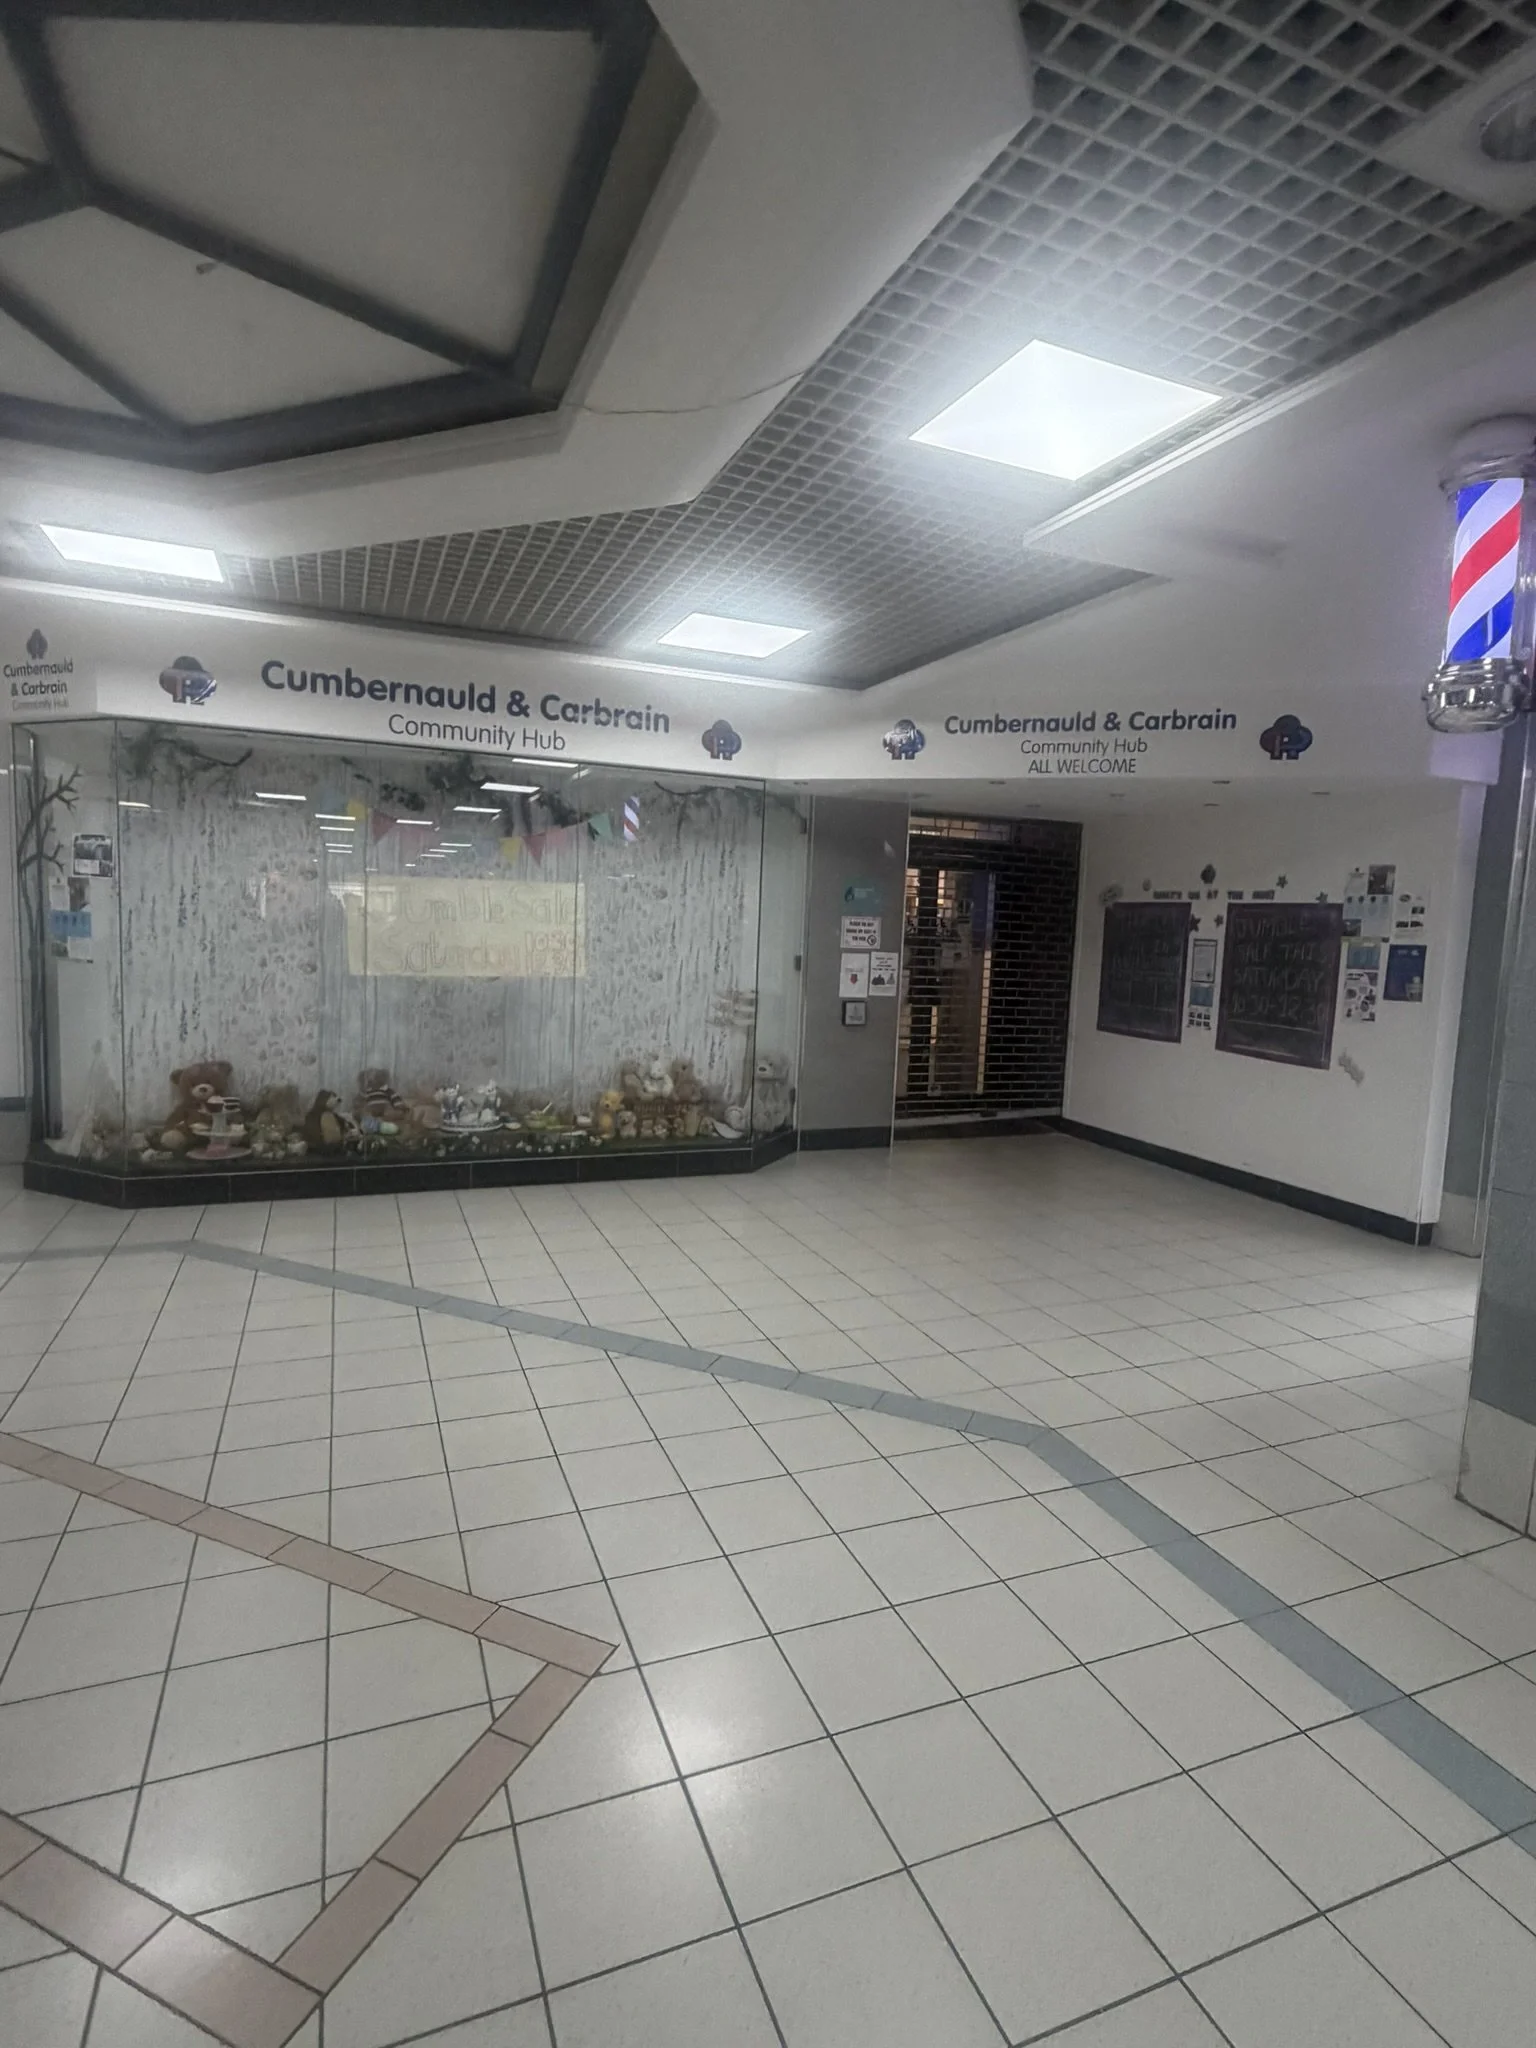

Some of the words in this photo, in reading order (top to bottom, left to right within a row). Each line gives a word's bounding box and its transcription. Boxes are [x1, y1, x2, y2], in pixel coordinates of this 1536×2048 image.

[3, 656, 74, 677] Cumbernauld
[22, 680, 68, 696] Carbrain
[261, 660, 496, 714] Cumbernauld
[507, 693, 530, 718] &
[540, 694, 670, 734] Carbrain
[388, 714, 516, 751] Community
[522, 729, 566, 751] Hub
[944, 711, 1096, 735] Cumbernauld
[1104, 712, 1121, 732] &
[1128, 709, 1237, 731] Carbrain
[1020, 739, 1109, 756] Community
[1114, 739, 1148, 754] Hub
[1028, 759, 1053, 774] ALL
[1057, 758, 1137, 774] WELCOME
